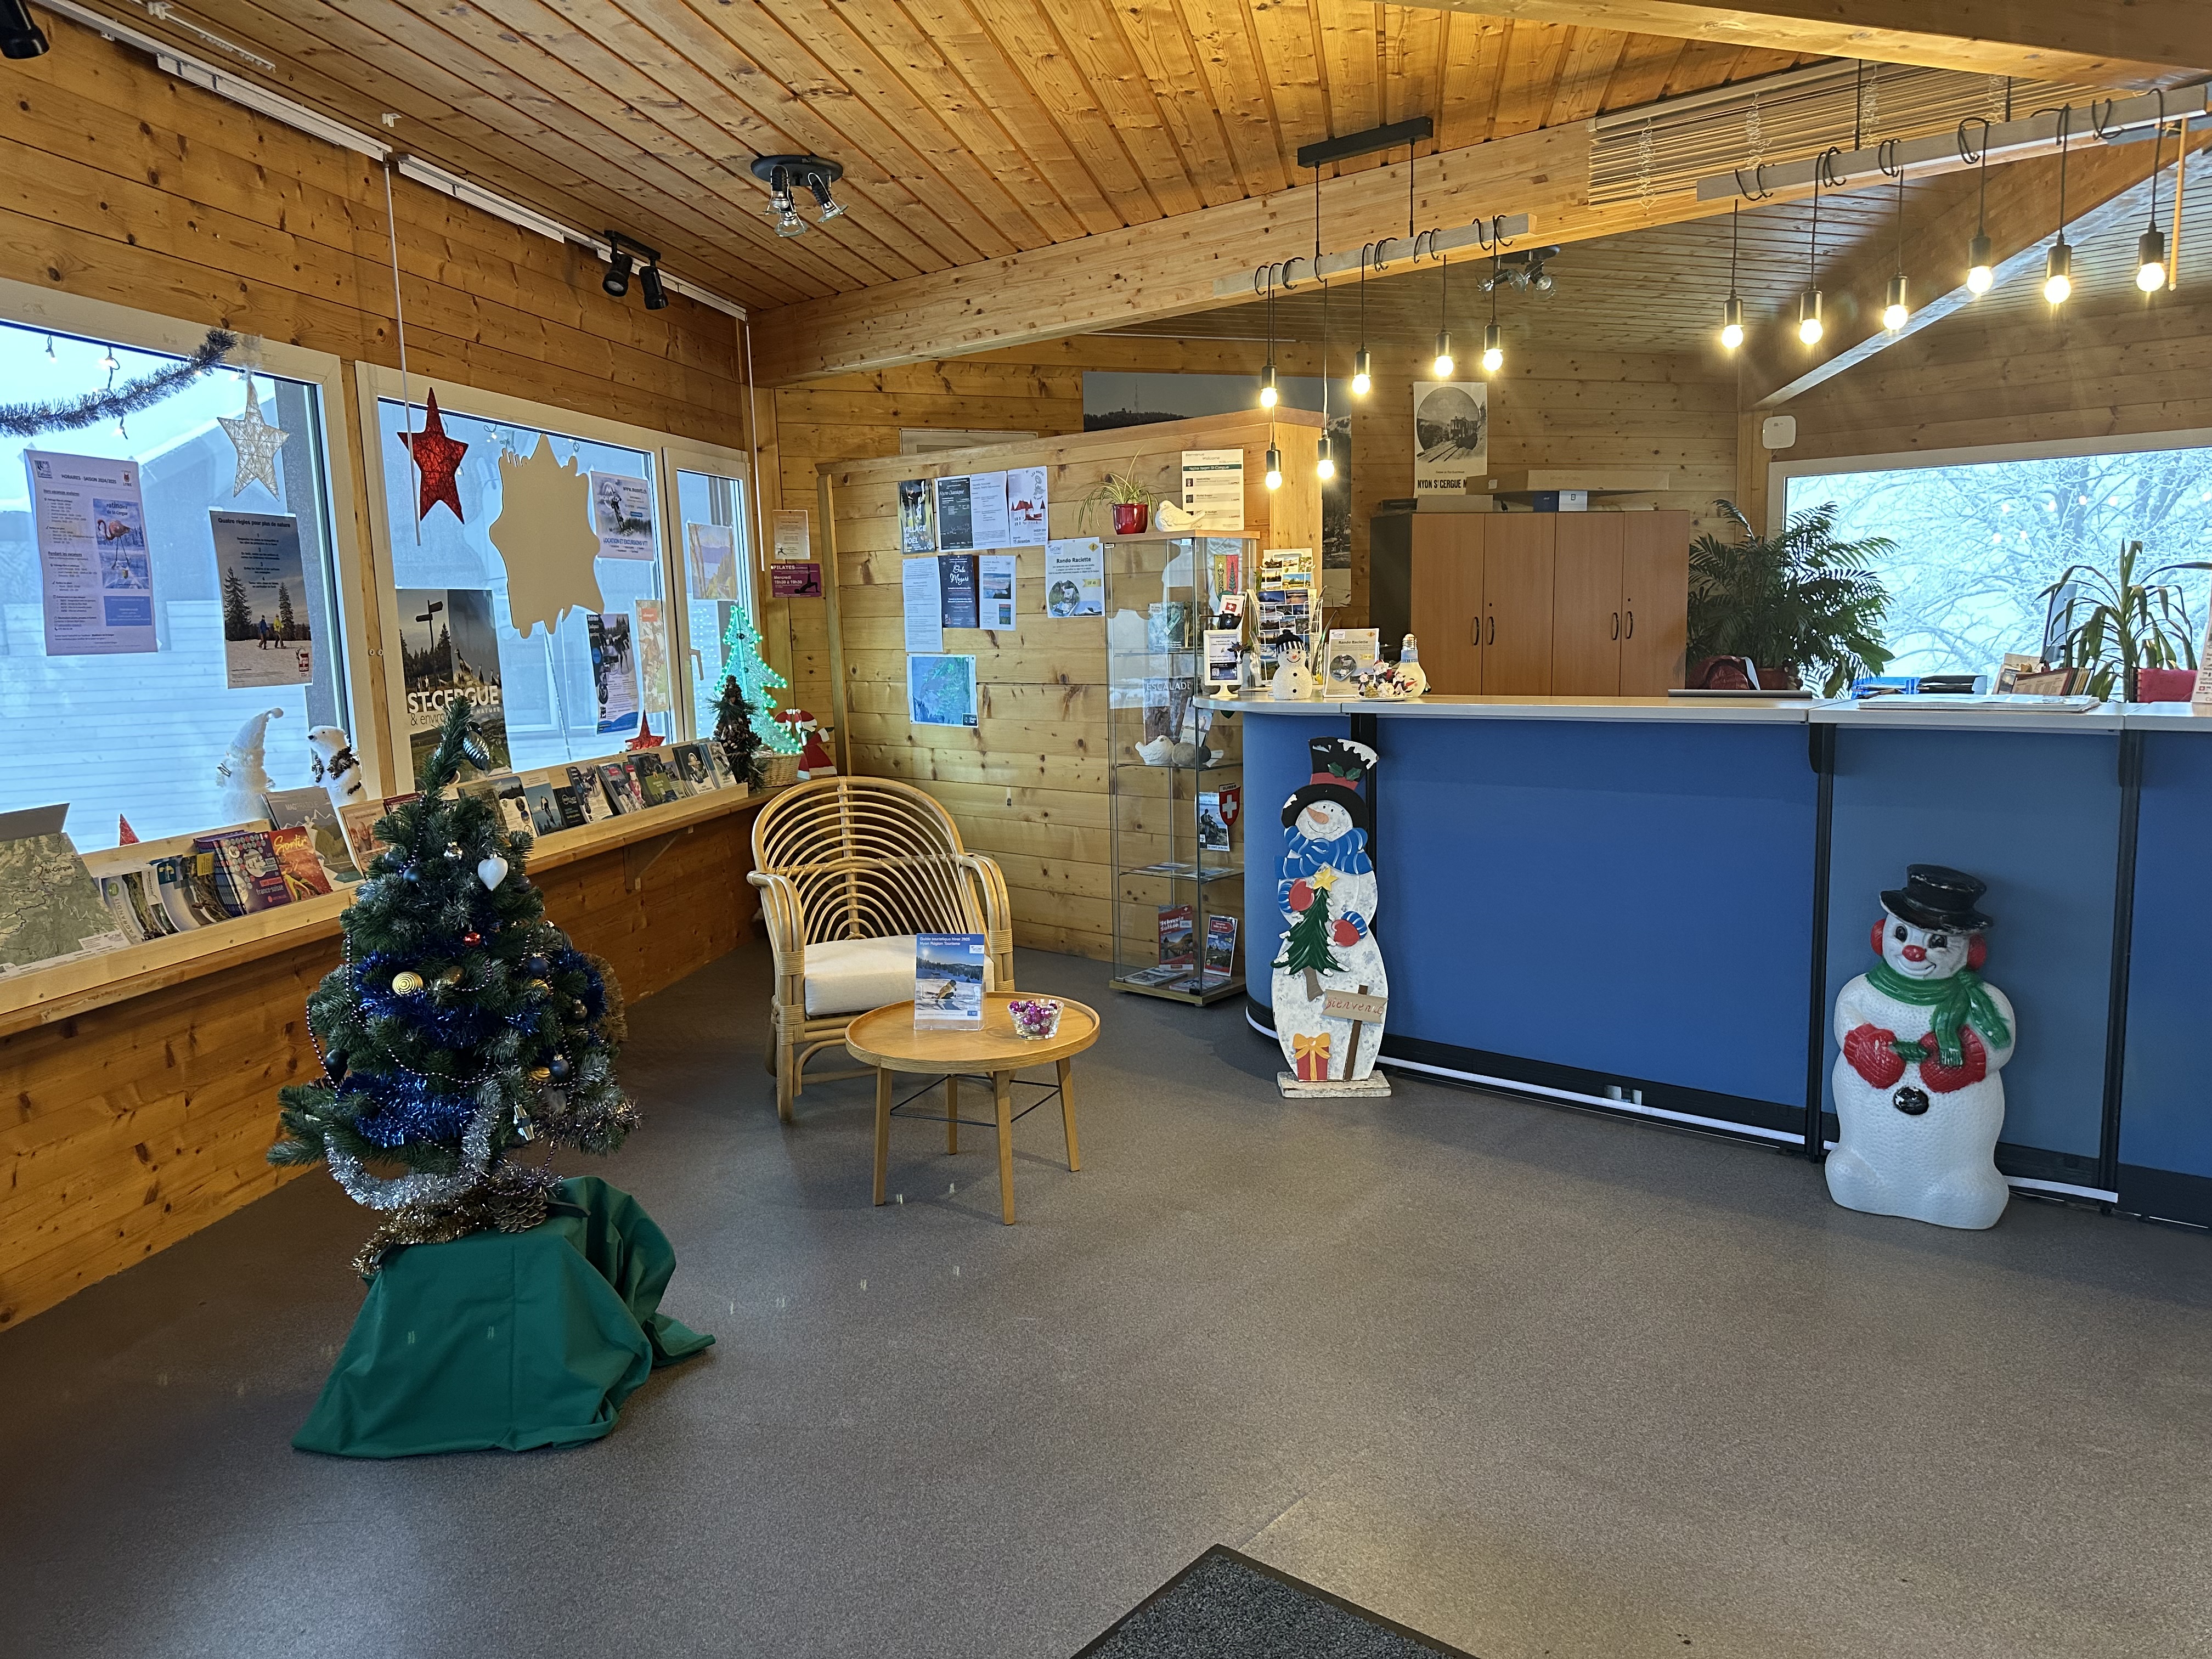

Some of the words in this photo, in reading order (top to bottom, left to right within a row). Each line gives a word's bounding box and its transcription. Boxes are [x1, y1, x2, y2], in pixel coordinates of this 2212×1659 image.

[1418, 479, 1432, 489] NYON
[1440, 479, 1462, 489] CERGUE
[904, 536, 918, 544] NOËL
[950, 573, 969, 585] Mozart
[411, 713, 418, 726] &
[274, 834, 307, 856] Sortir
[44, 864, 73, 874] St-Cergue
[1325, 996, 1383, 1015] Bienvenue
